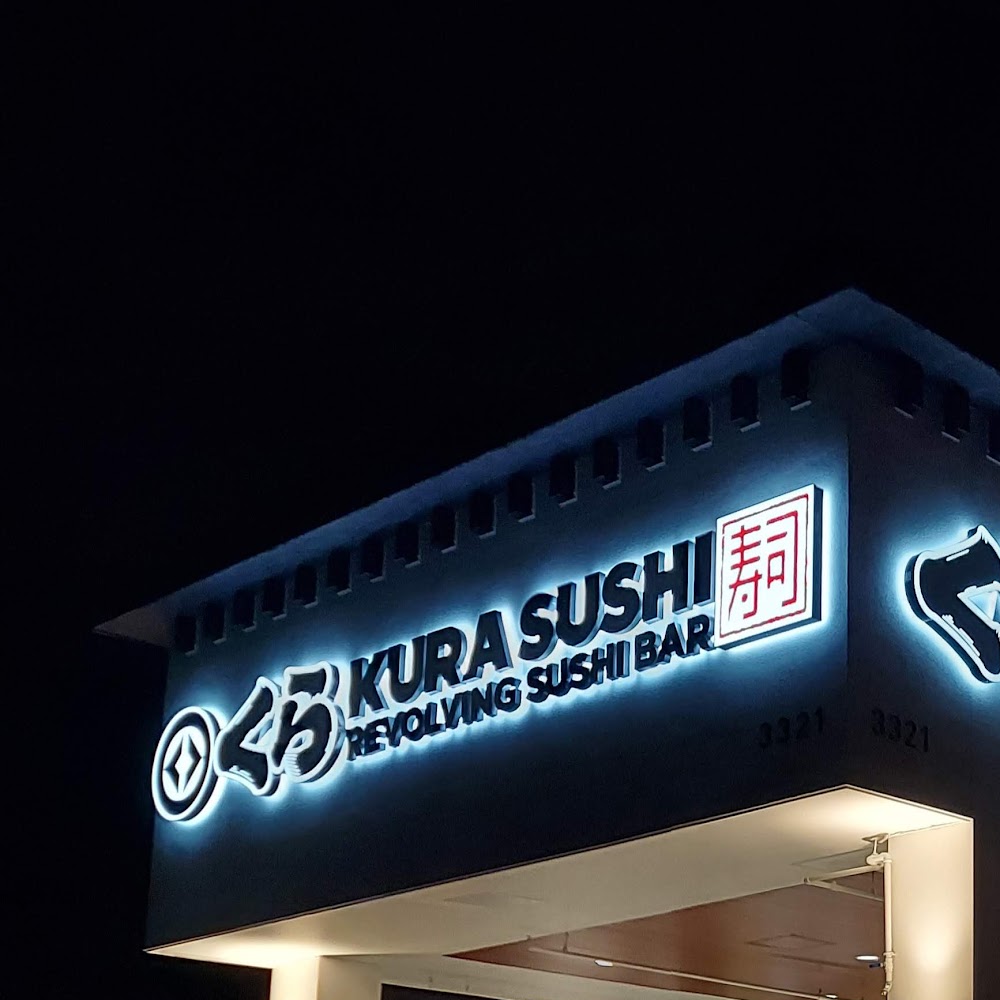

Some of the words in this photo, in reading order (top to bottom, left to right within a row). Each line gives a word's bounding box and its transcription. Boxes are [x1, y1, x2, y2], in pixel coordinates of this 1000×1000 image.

[346, 677, 522, 761] REVOLVING
[526, 640, 631, 704] SUSHI
[634, 614, 718, 672] BAR
[348, 610, 513, 718] KURA
[518, 531, 715, 661] SUSHI
[871, 707, 930, 752] 3321
